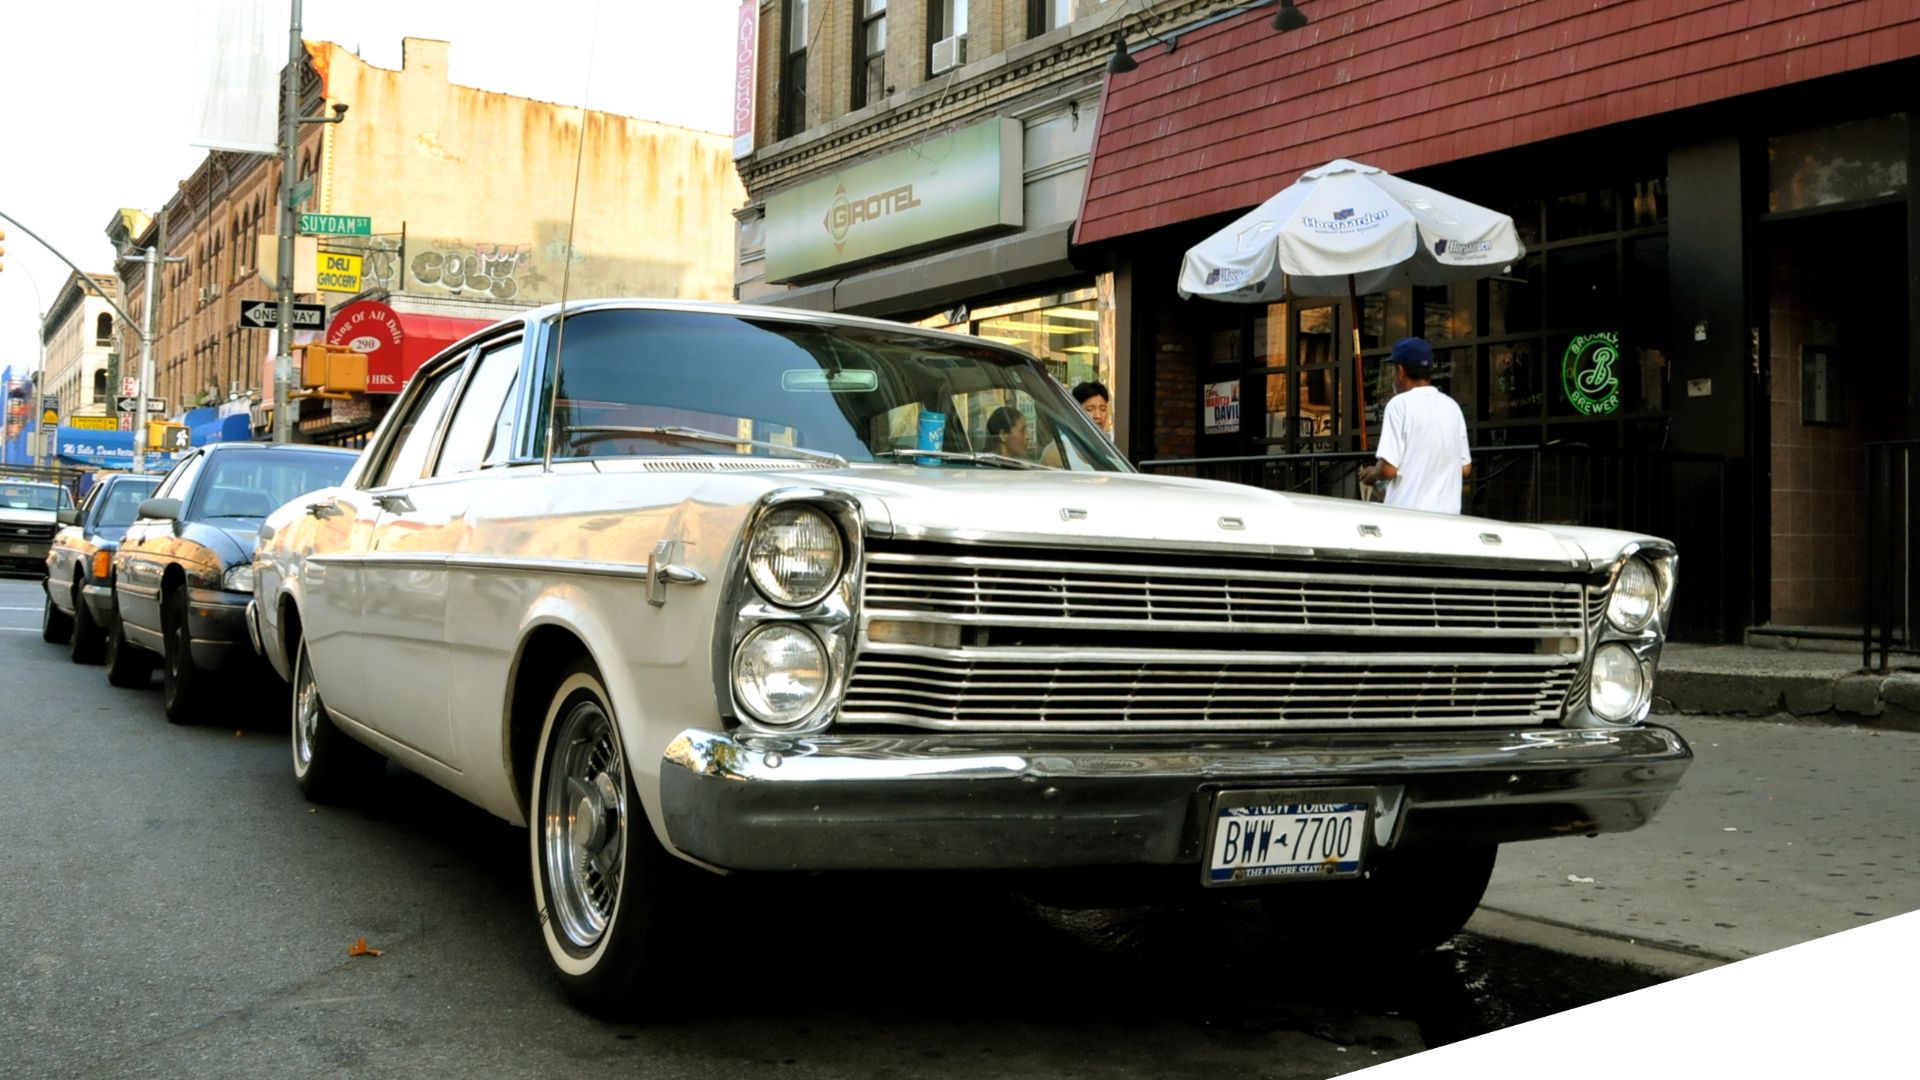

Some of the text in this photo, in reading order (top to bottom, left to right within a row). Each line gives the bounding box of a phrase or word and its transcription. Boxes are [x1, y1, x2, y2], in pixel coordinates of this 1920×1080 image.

[736, 18, 753, 132] AUTO SCHOOL
[832, 184, 921, 229] GIROTEL
[301, 215, 369, 234] SUYDAM ST
[1302, 209, 1389, 231] Hoegaarden
[326, 257, 350, 271] DELI
[317, 273, 357, 288] GROCERY
[253, 308, 277, 320] ONE
[330, 322, 353, 345] King
[352, 311, 366, 323] Of
[368, 310, 386, 321] All
[356, 339, 375, 350] 290
[371, 374, 395, 384] HRS.
[1571, 391, 1619, 413] BREWER
[1060, 508, 1502, 545] FORD
[1223, 816, 1353, 865] BWW 7700
[1246, 868, 1263, 877] THE
[1265, 866, 1297, 876] EMPIRE
